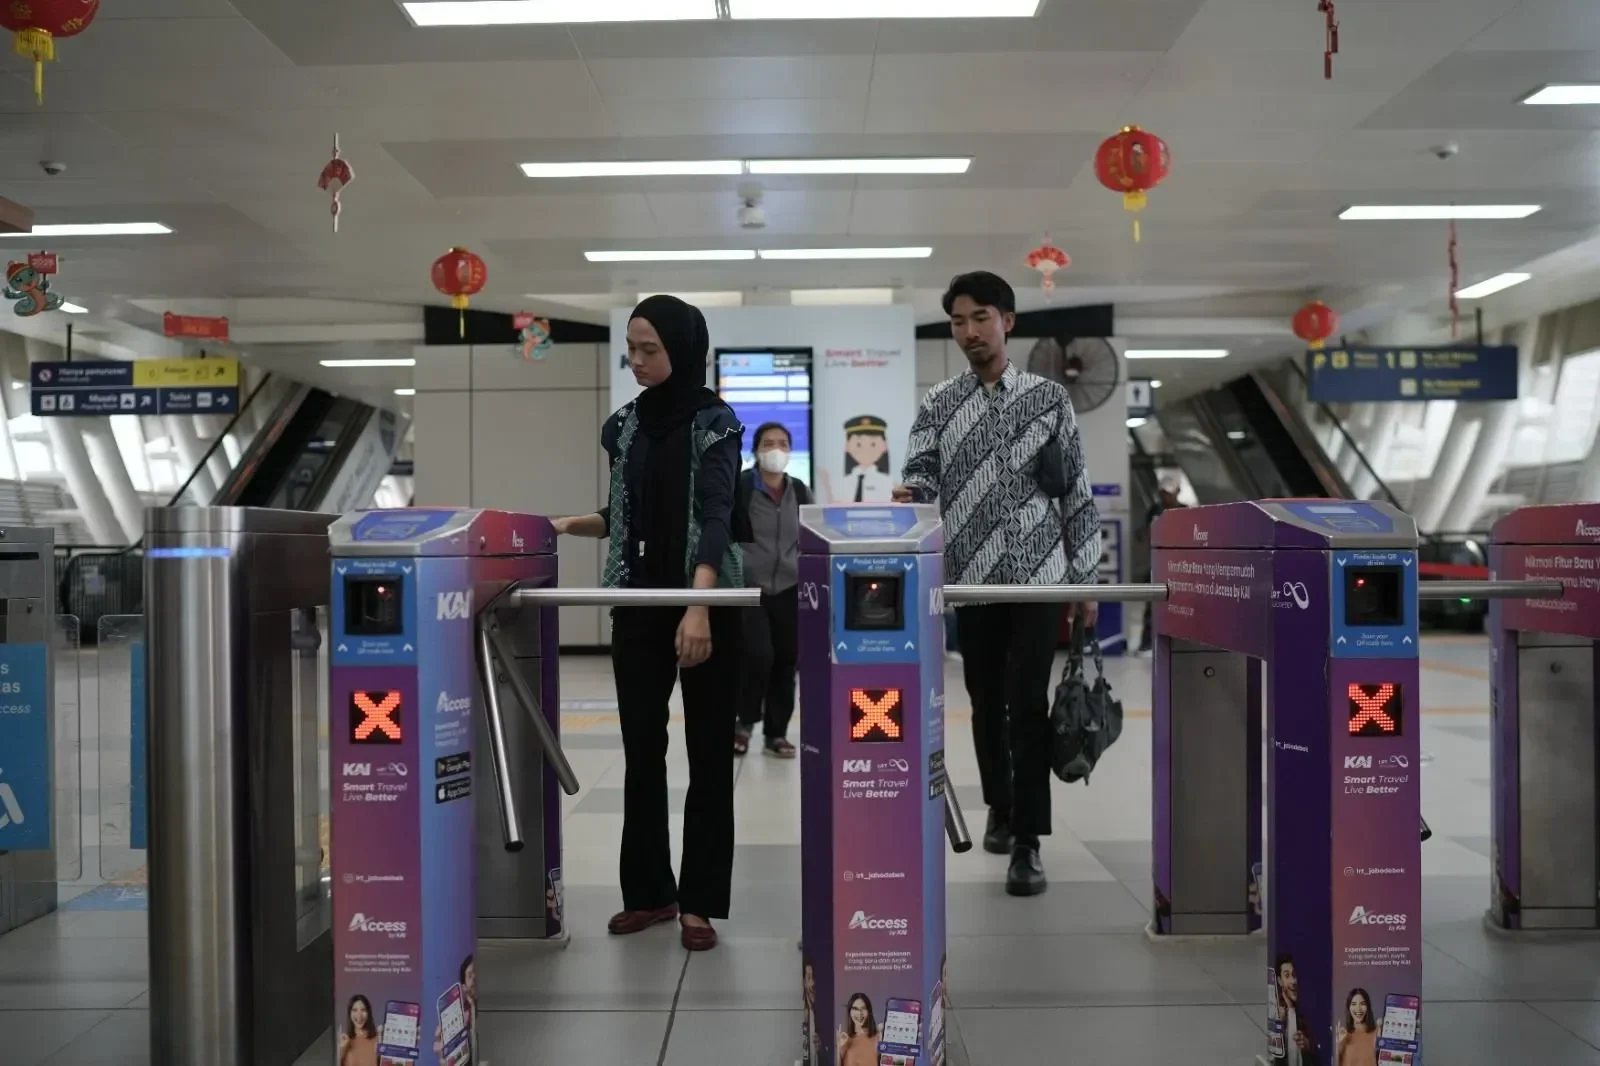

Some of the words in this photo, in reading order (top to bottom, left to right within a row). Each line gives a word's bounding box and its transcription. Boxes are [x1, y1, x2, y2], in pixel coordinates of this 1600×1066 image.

[1574, 556, 1594, 569] Baru
[843, 760, 871, 773] KAI
[1344, 756, 1372, 768] KAI
[343, 763, 371, 776] KAI
[843, 780, 875, 788] Smart
[878, 778, 909, 788] Travel
[1344, 776, 1376, 784] Smart
[1378, 775, 1408, 783] Travel
[343, 783, 375, 791] Smart
[377, 782, 408, 791] Travel
[1344, 786, 1364, 794] Live
[1366, 786, 1399, 794] Better
[343, 793, 363, 801] Live
[365, 793, 398, 801] Better
[843, 790, 863, 798] Live
[865, 790, 900, 798] Better
[848, 910, 908, 929] Access
[1348, 906, 1407, 925] Access
[348, 913, 407, 931] Access
